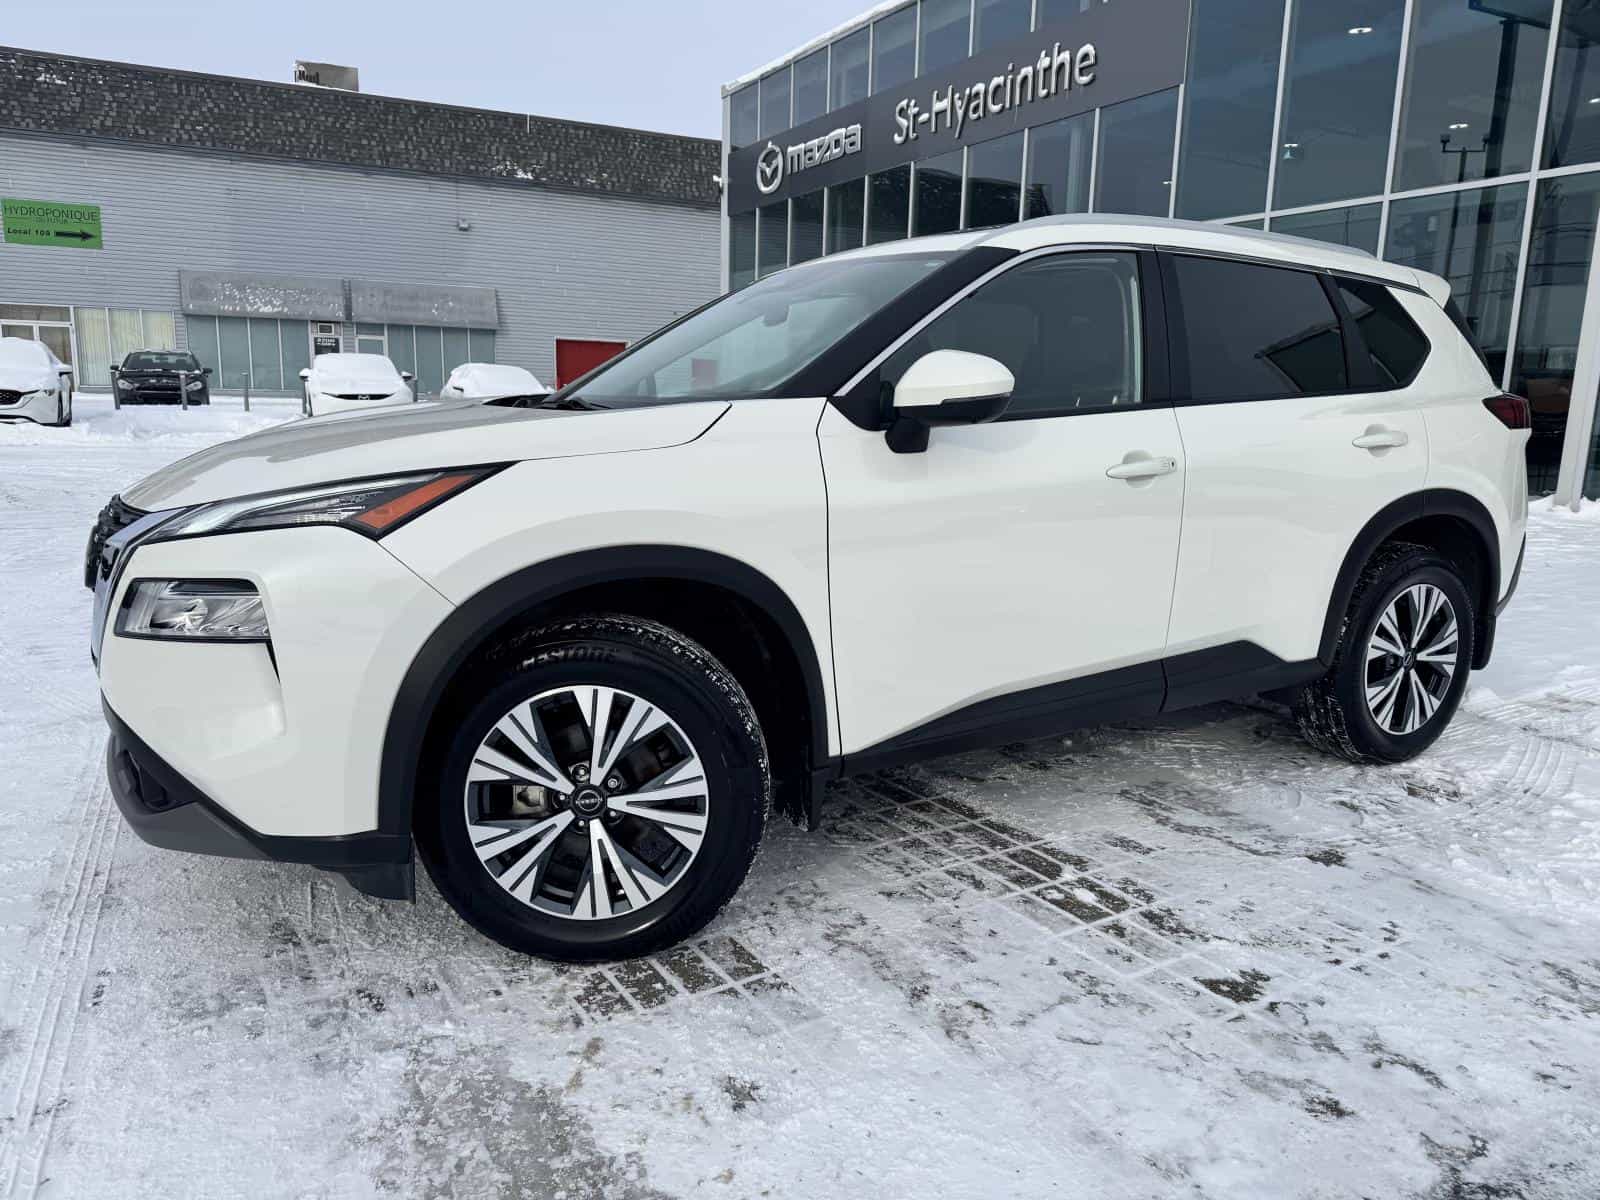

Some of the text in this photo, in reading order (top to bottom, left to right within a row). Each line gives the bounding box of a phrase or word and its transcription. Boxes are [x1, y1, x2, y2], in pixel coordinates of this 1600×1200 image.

[893, 42, 1096, 144] St-Hyacinthe
[787, 123, 862, 175] mazda
[4, 205, 97, 220] HYDROPONIQUE
[7, 227, 31, 236] Local
